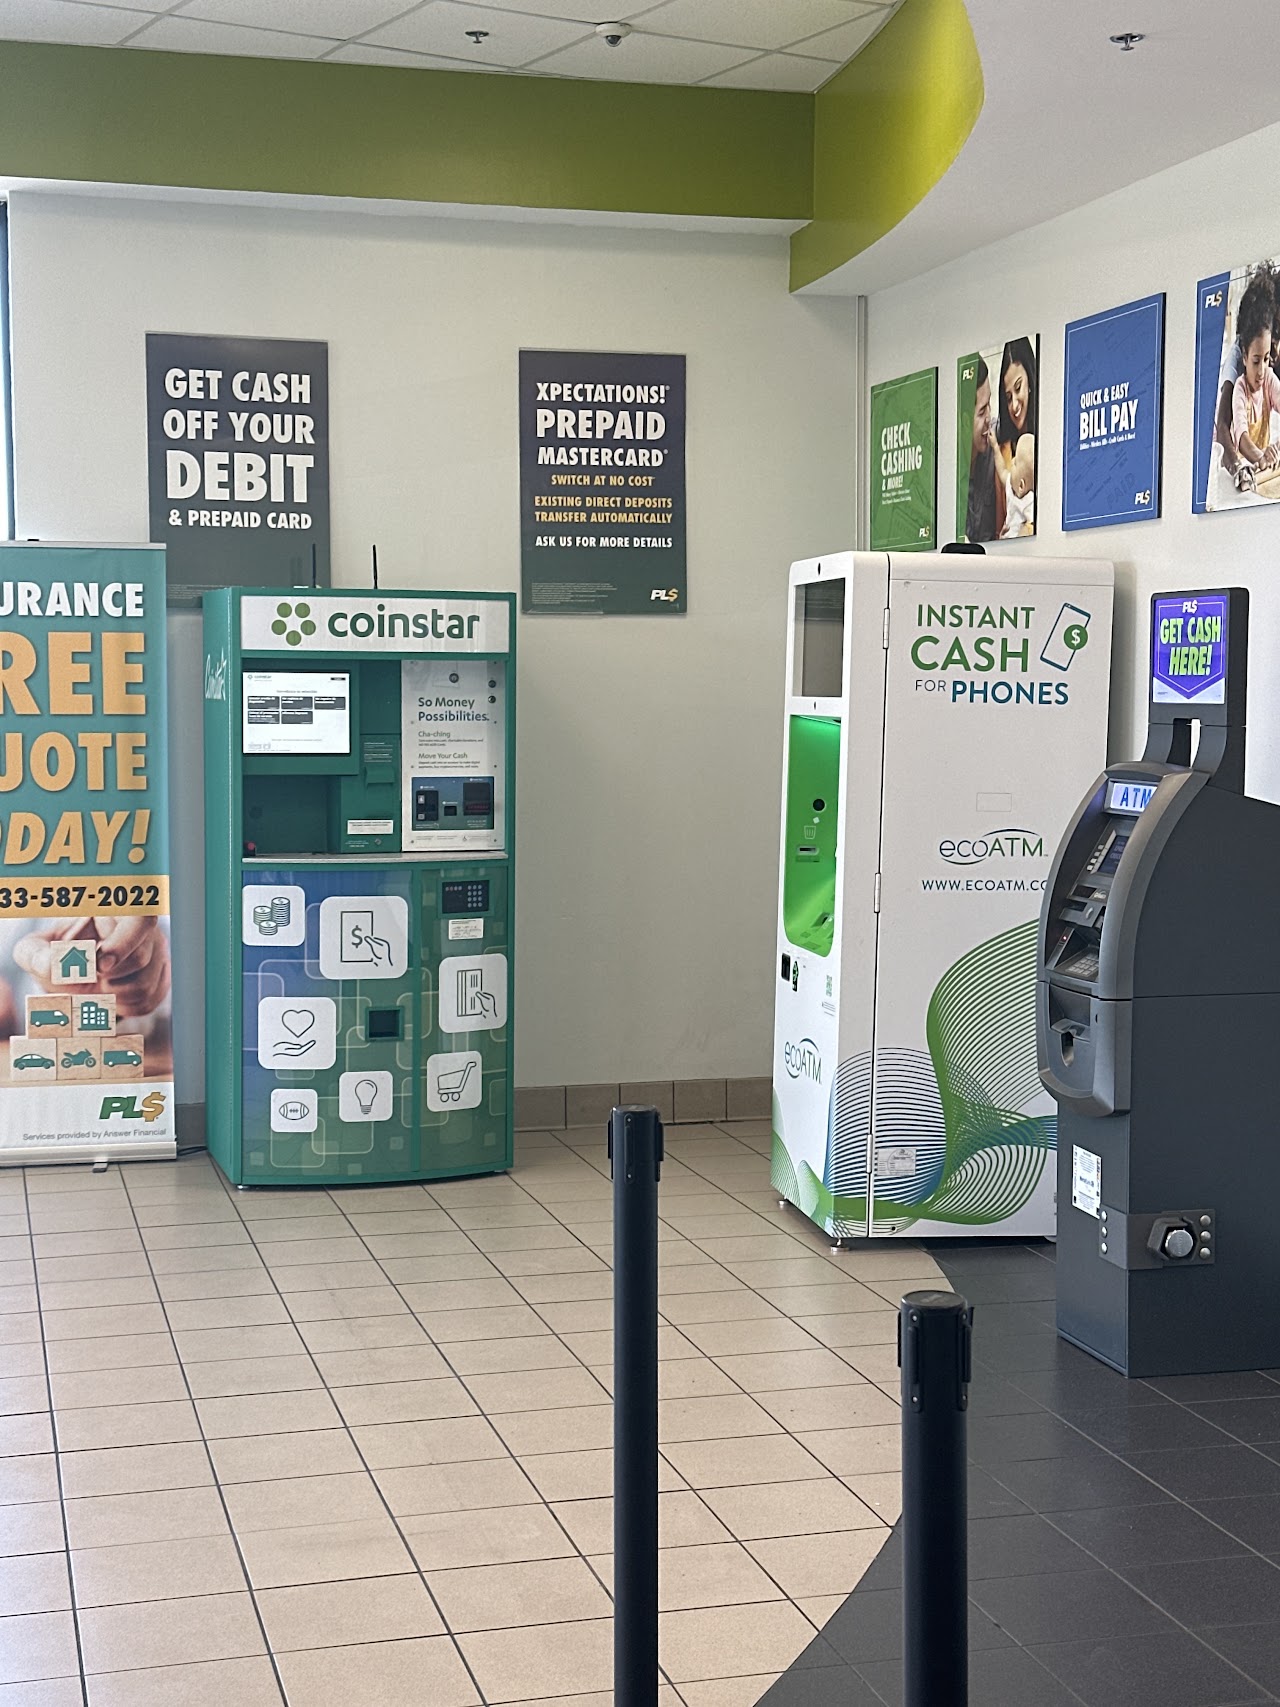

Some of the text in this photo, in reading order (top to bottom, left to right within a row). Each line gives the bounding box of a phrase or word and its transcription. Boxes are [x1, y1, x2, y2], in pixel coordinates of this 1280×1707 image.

[165, 368, 311, 404] GET CASH
[1080, 382, 1129, 409] QUICK & EASY
[163, 408, 315, 444] OFF YOUR
[536, 408, 666, 440] PREPAID
[1080, 399, 1138, 440] BILL PAY
[881, 422, 911, 451] CHECK
[881, 445, 922, 476] CASHING
[166, 449, 314, 503] DEBIT
[551, 474, 654, 487] SWITCH AT NO COST
[534, 496, 673, 509] EXISTING DIRECT DEPOSITS
[168, 509, 312, 530] & PREPAID CARD
[535, 511, 673, 524] TRANSFER AUTOMATICALLY
[535, 536, 673, 548] ASK US FOR MORE DETAILS
[328, 603, 480, 639] coinstar
[917, 604, 1035, 629] INSTANT
[1160, 616, 1221, 644] GET CASH
[910, 636, 1029, 672] CASH
[1169, 645, 1212, 676] HERE!
[418, 697, 475, 709] So Money
[915, 680, 1069, 705] FOR PHONES
[1120, 787, 1152, 808] ATM
[939, 837, 1043, 858] ecoATM
[785, 1041, 821, 1085] ecoATM
[23, 1128, 167, 1141] Services provided by Answer Financial
